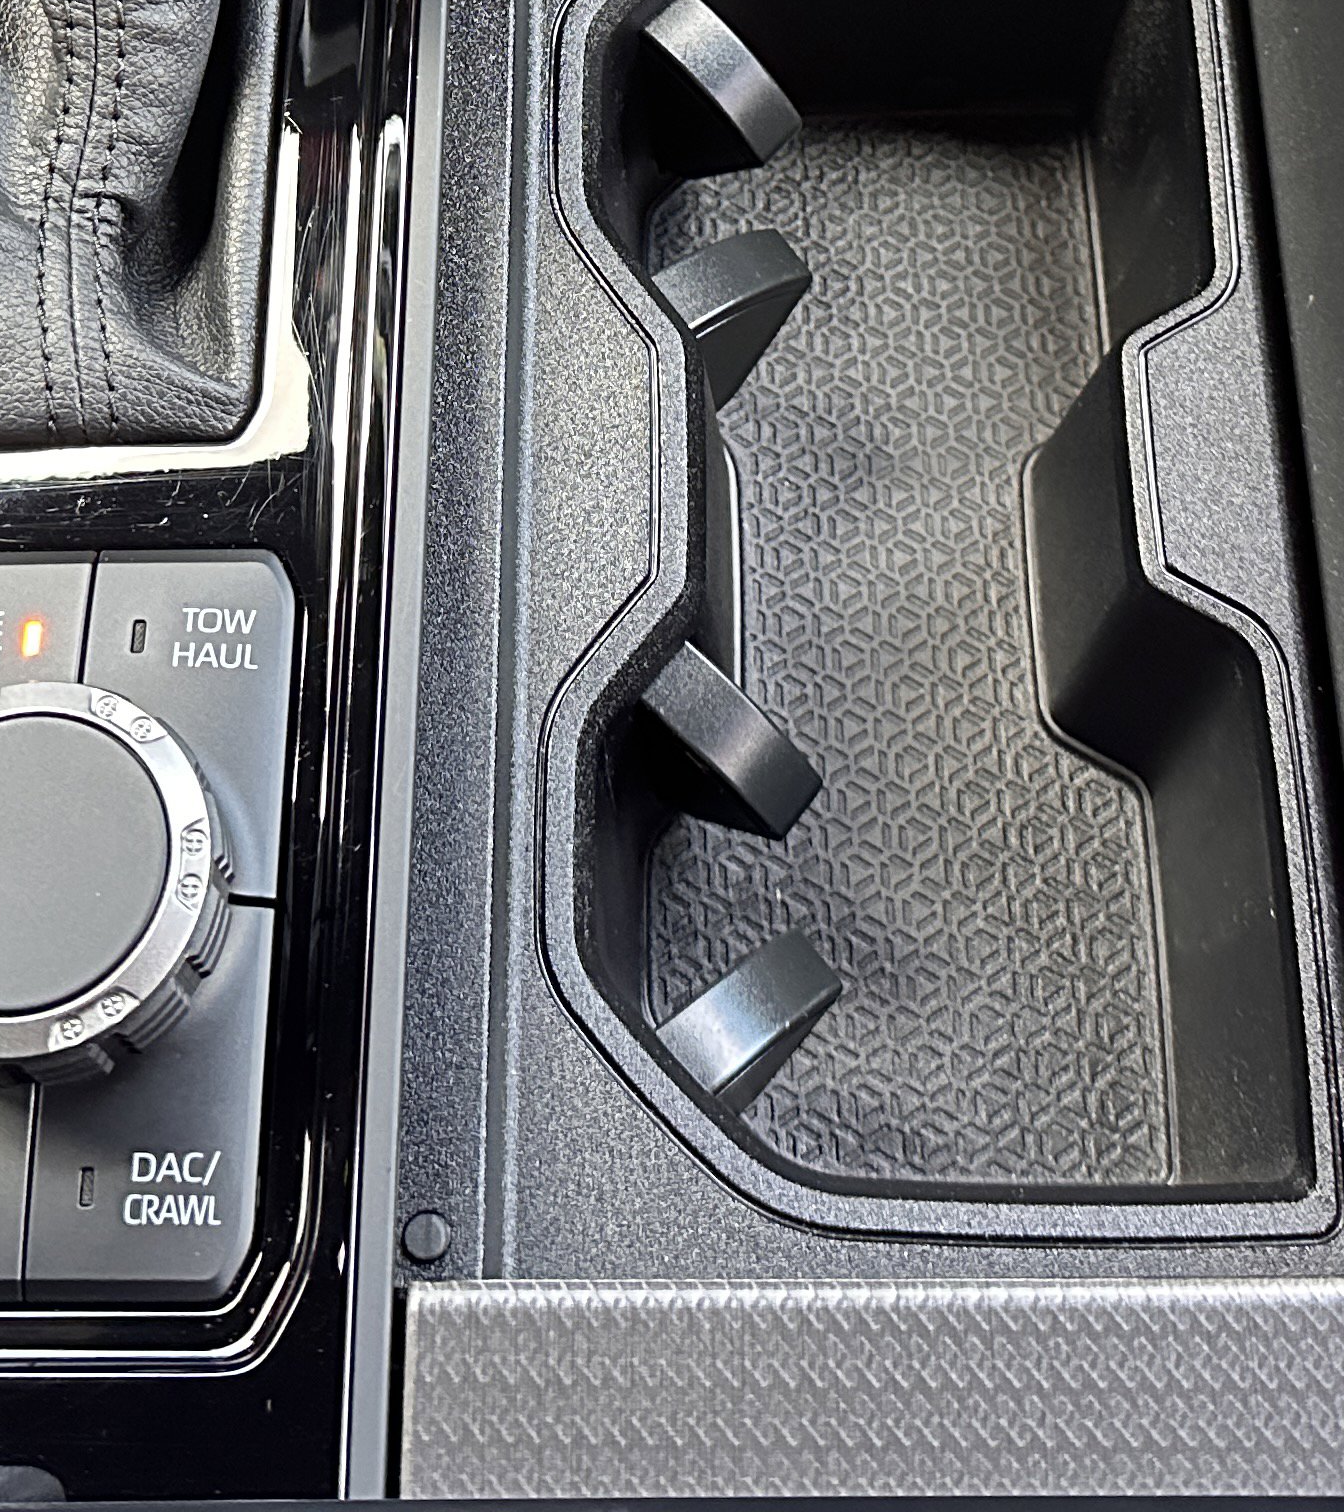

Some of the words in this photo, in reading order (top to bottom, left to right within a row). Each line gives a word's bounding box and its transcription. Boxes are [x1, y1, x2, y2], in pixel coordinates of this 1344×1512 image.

[182, 607, 257, 634] TOW
[171, 641, 259, 670] HAUL
[131, 1150, 222, 1186] DAC/
[124, 1193, 222, 1226] CRAWL
